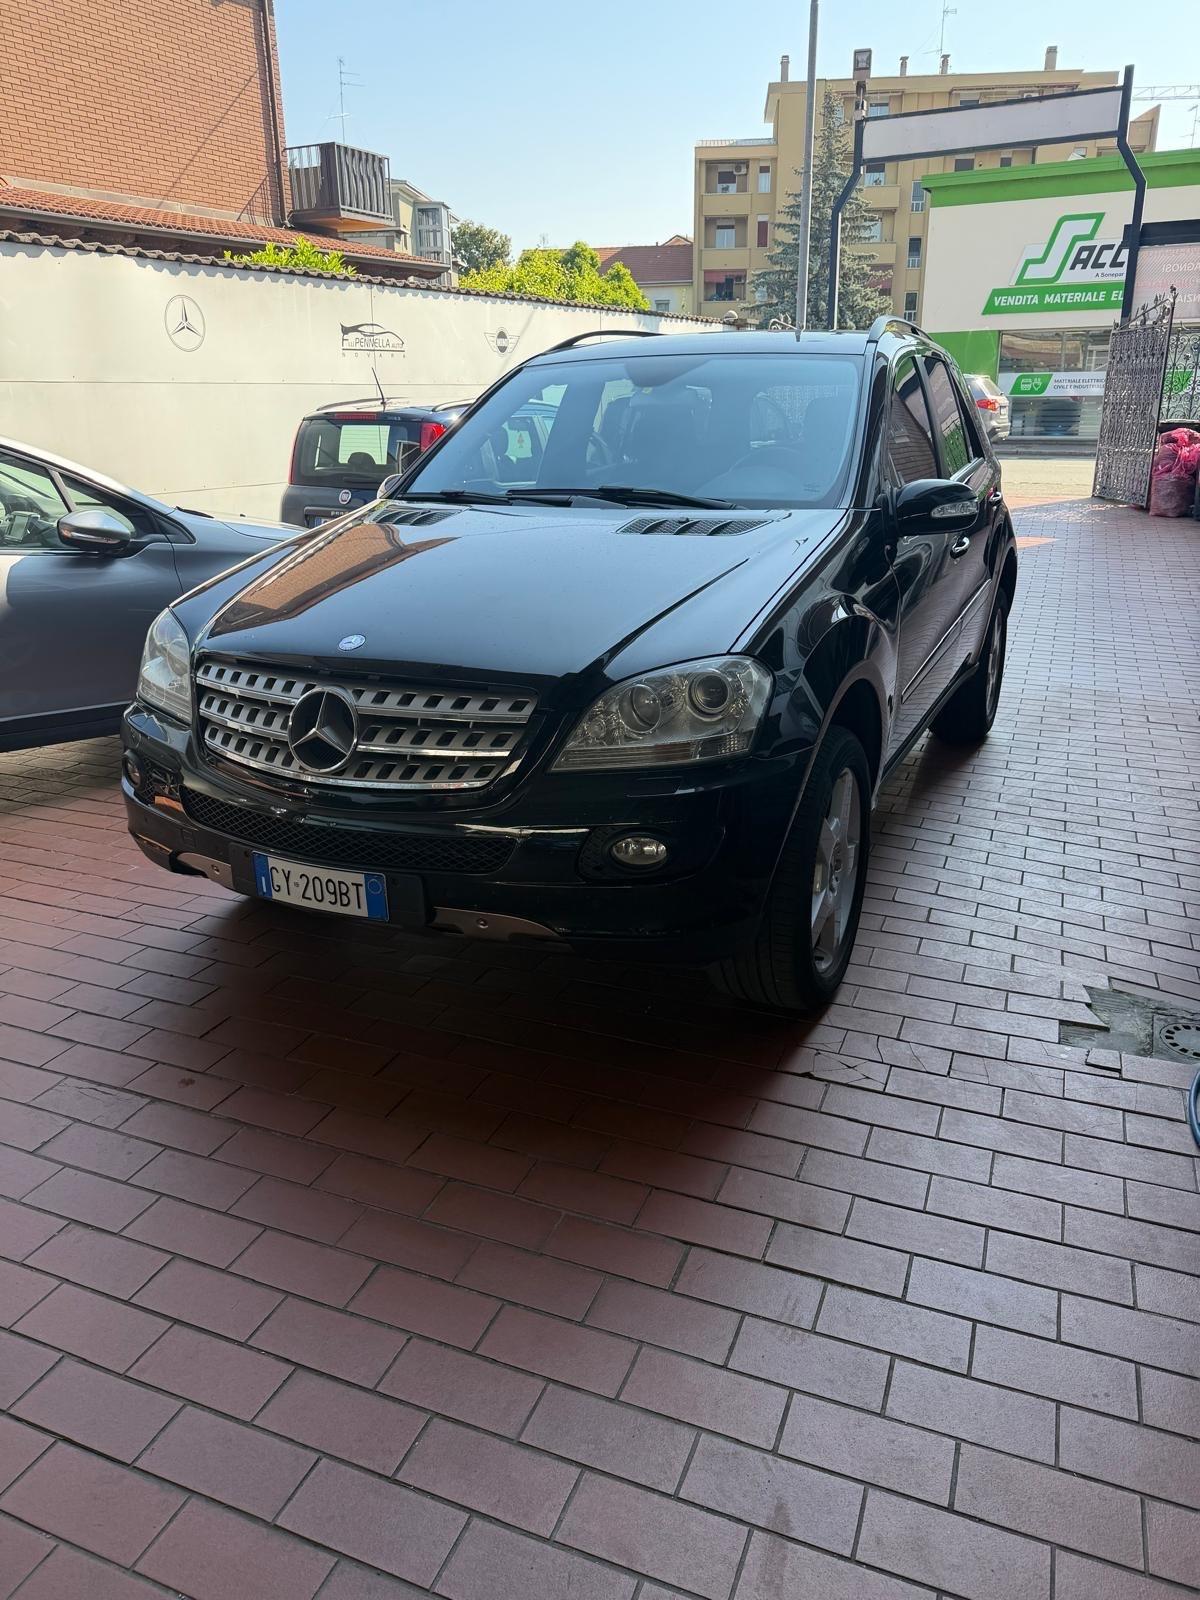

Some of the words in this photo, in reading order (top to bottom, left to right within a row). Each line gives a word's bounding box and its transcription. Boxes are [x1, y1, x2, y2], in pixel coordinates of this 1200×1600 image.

[994, 295, 1039, 306] VENDITA
[1044, 291, 1106, 304] MATERIALE
[355, 337, 391, 348] PENNELLA
